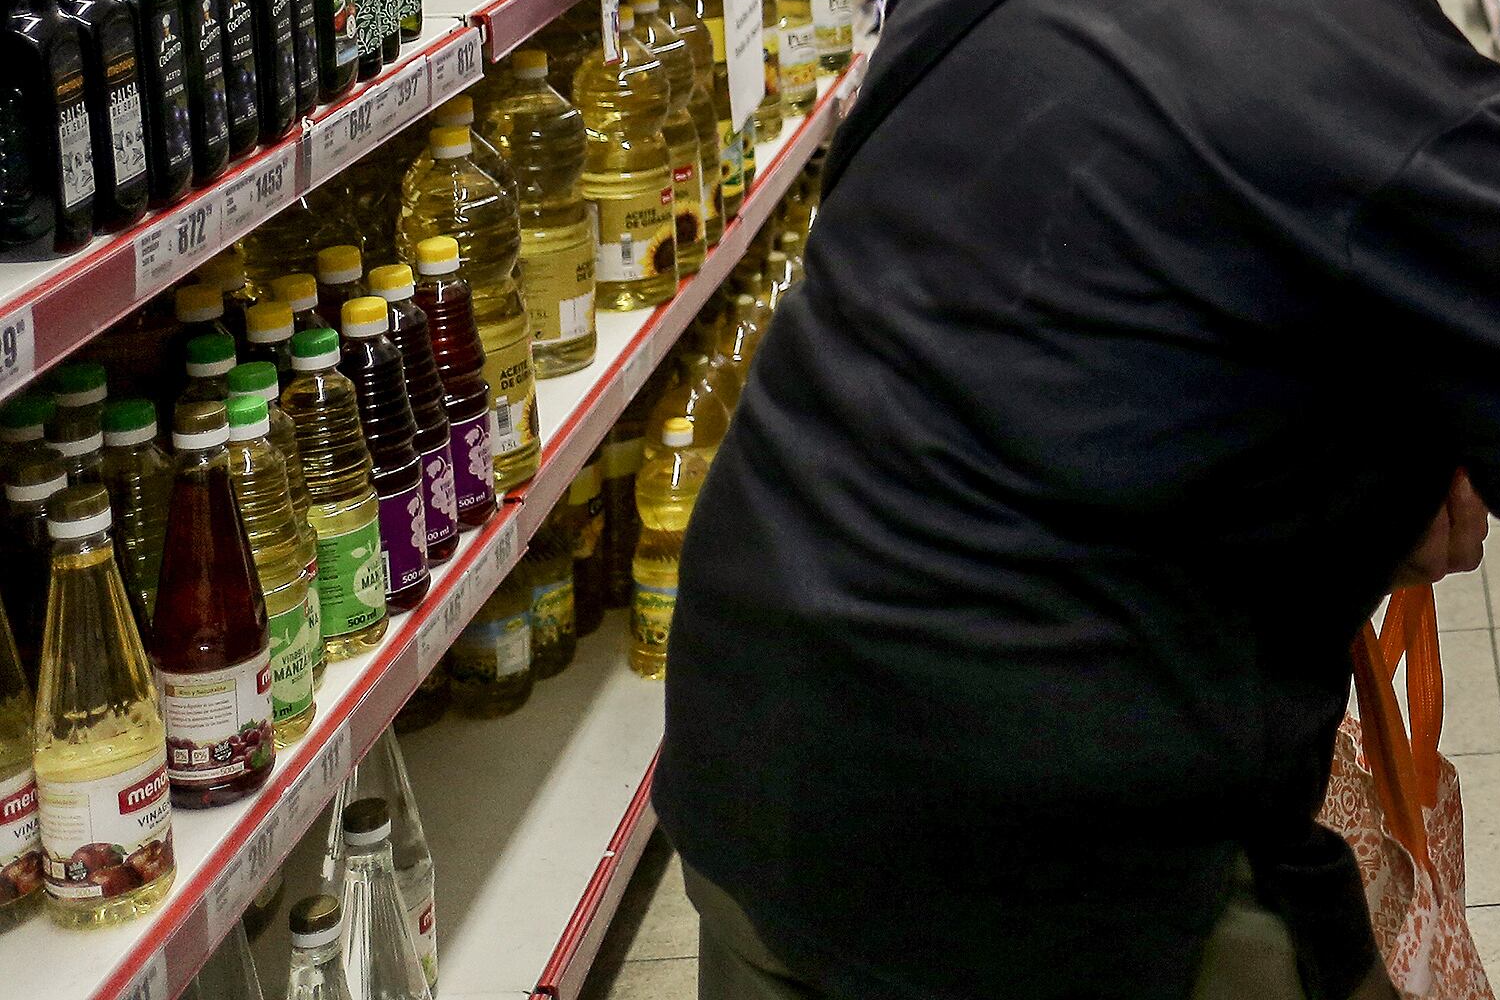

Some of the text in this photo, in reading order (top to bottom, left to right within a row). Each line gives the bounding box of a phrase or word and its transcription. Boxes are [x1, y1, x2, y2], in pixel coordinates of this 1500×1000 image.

[227, 8, 252, 33] Cocinero
[200, 25, 221, 51] Cocinero
[233, 34, 251, 47] ACETO
[159, 41, 183, 68] Cocinero
[165, 68, 182, 82] ACETO
[110, 82, 139, 107] SALSA
[61, 100, 87, 127] SALSA
[458, 495, 475, 509] 500
[402, 570, 419, 585] 500
[347, 613, 366, 629] 500
